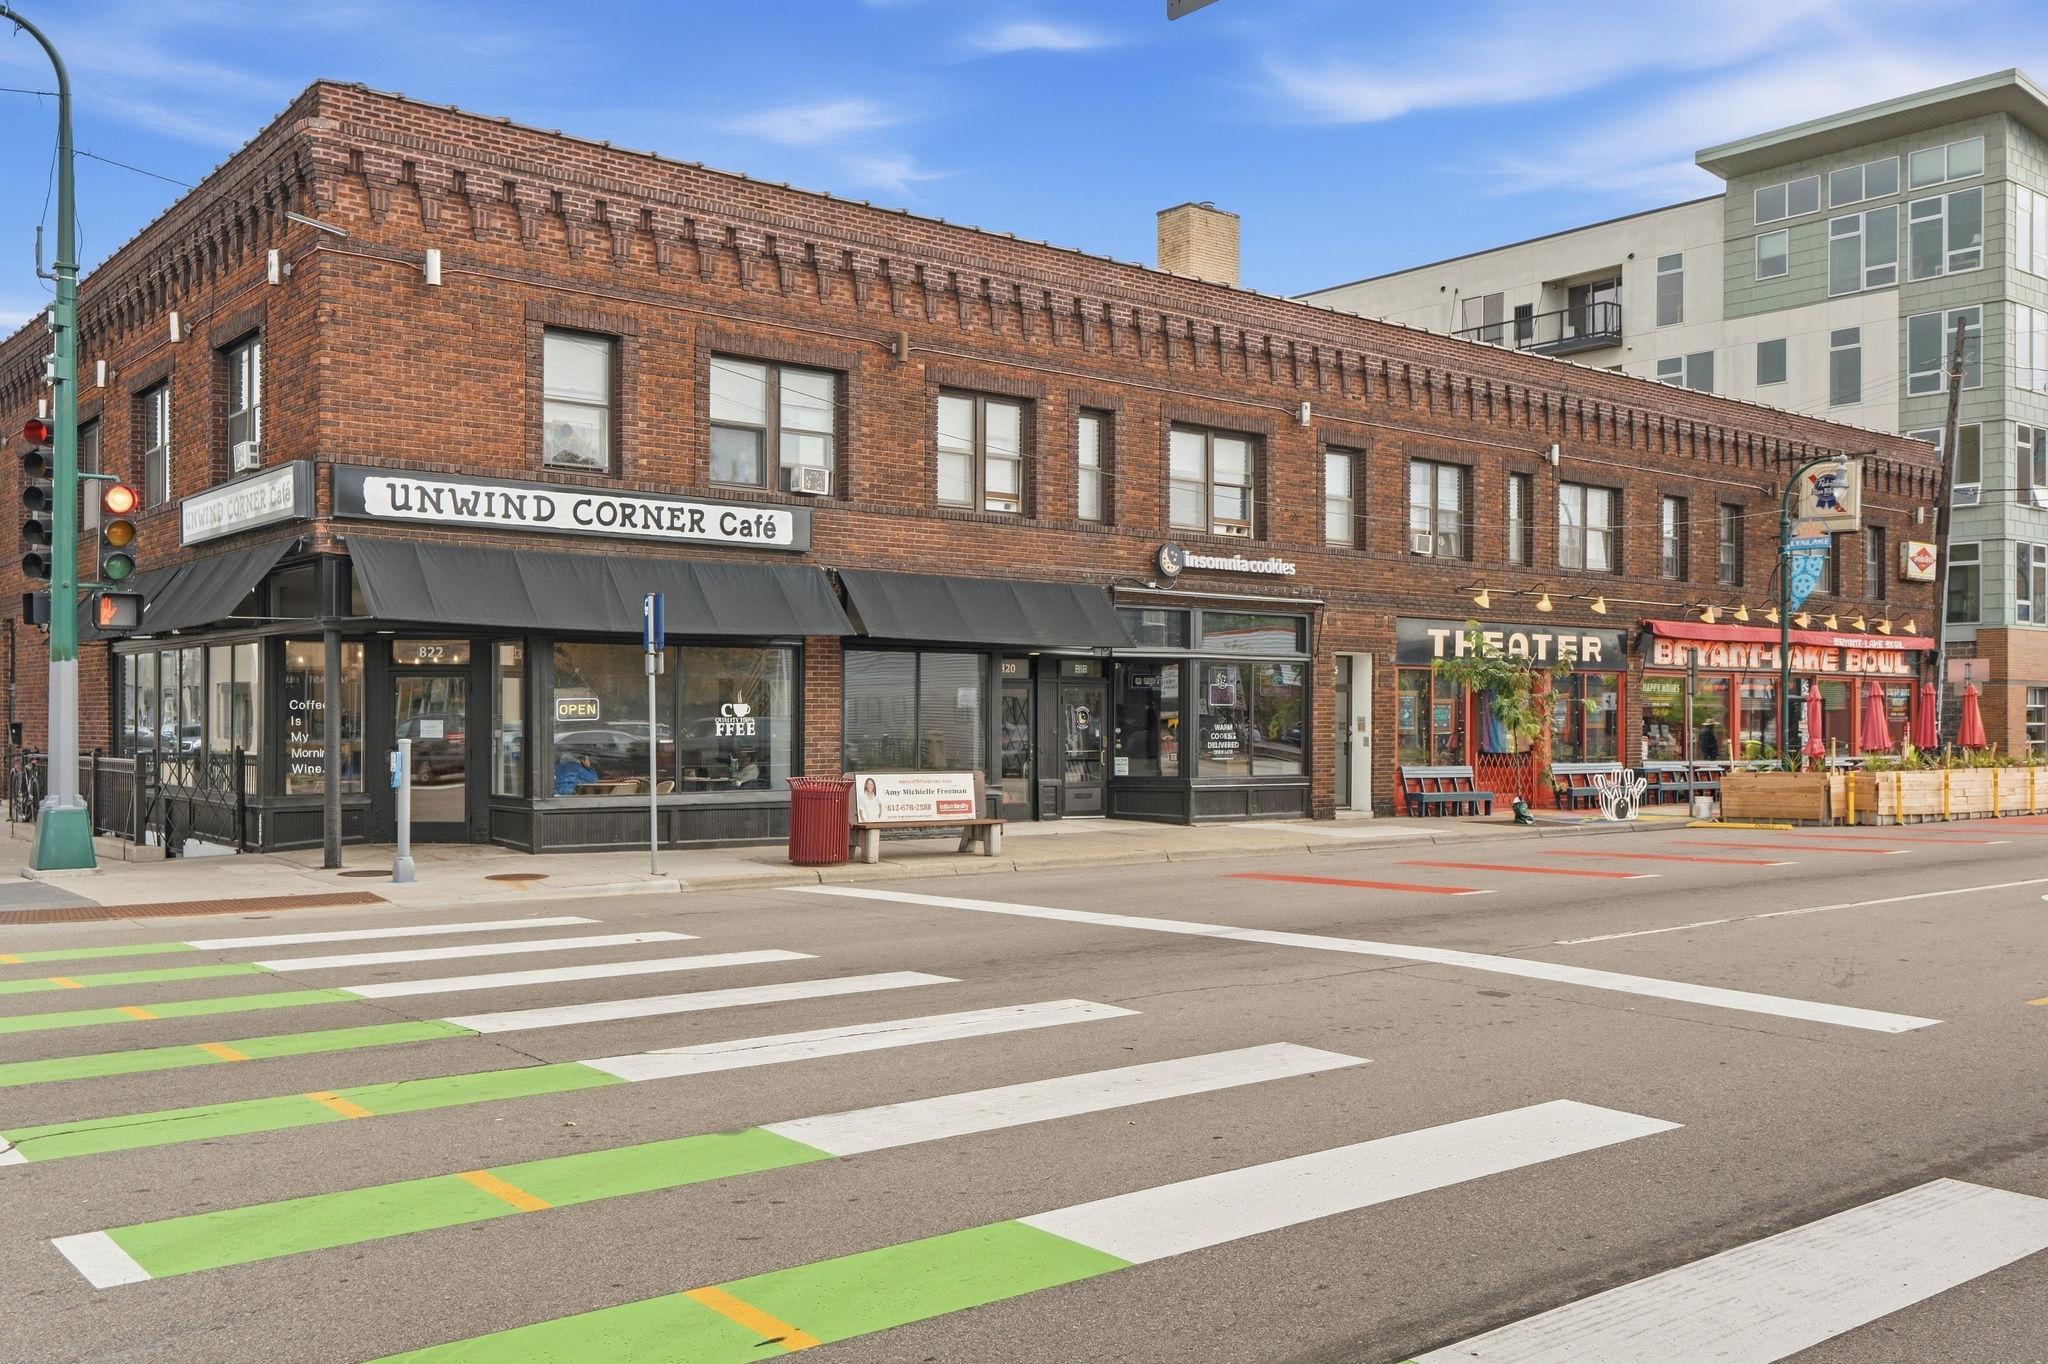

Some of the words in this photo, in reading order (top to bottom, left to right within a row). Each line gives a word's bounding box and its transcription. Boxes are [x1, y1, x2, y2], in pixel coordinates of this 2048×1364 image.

[185, 501, 223, 530] UNWIND
[227, 489, 267, 519] CORNER
[269, 480, 291, 507] Café
[385, 483, 556, 521] UNWIND
[572, 499, 706, 533] CORNER
[719, 511, 777, 539] Café
[1182, 550, 1248, 571] insomnia
[1248, 557, 1296, 575] cookies
[1427, 628, 1602, 662] THEATER
[419, 647, 444, 657] 822
[1846, 649, 1911, 674] BOWL
[289, 700, 325, 710] Coffe
[559, 704, 596, 715] OPEN
[291, 716, 302, 726] Is
[291, 732, 309, 743] My
[291, 748, 325, 758] Morni
[292, 764, 325, 774] Wine.
